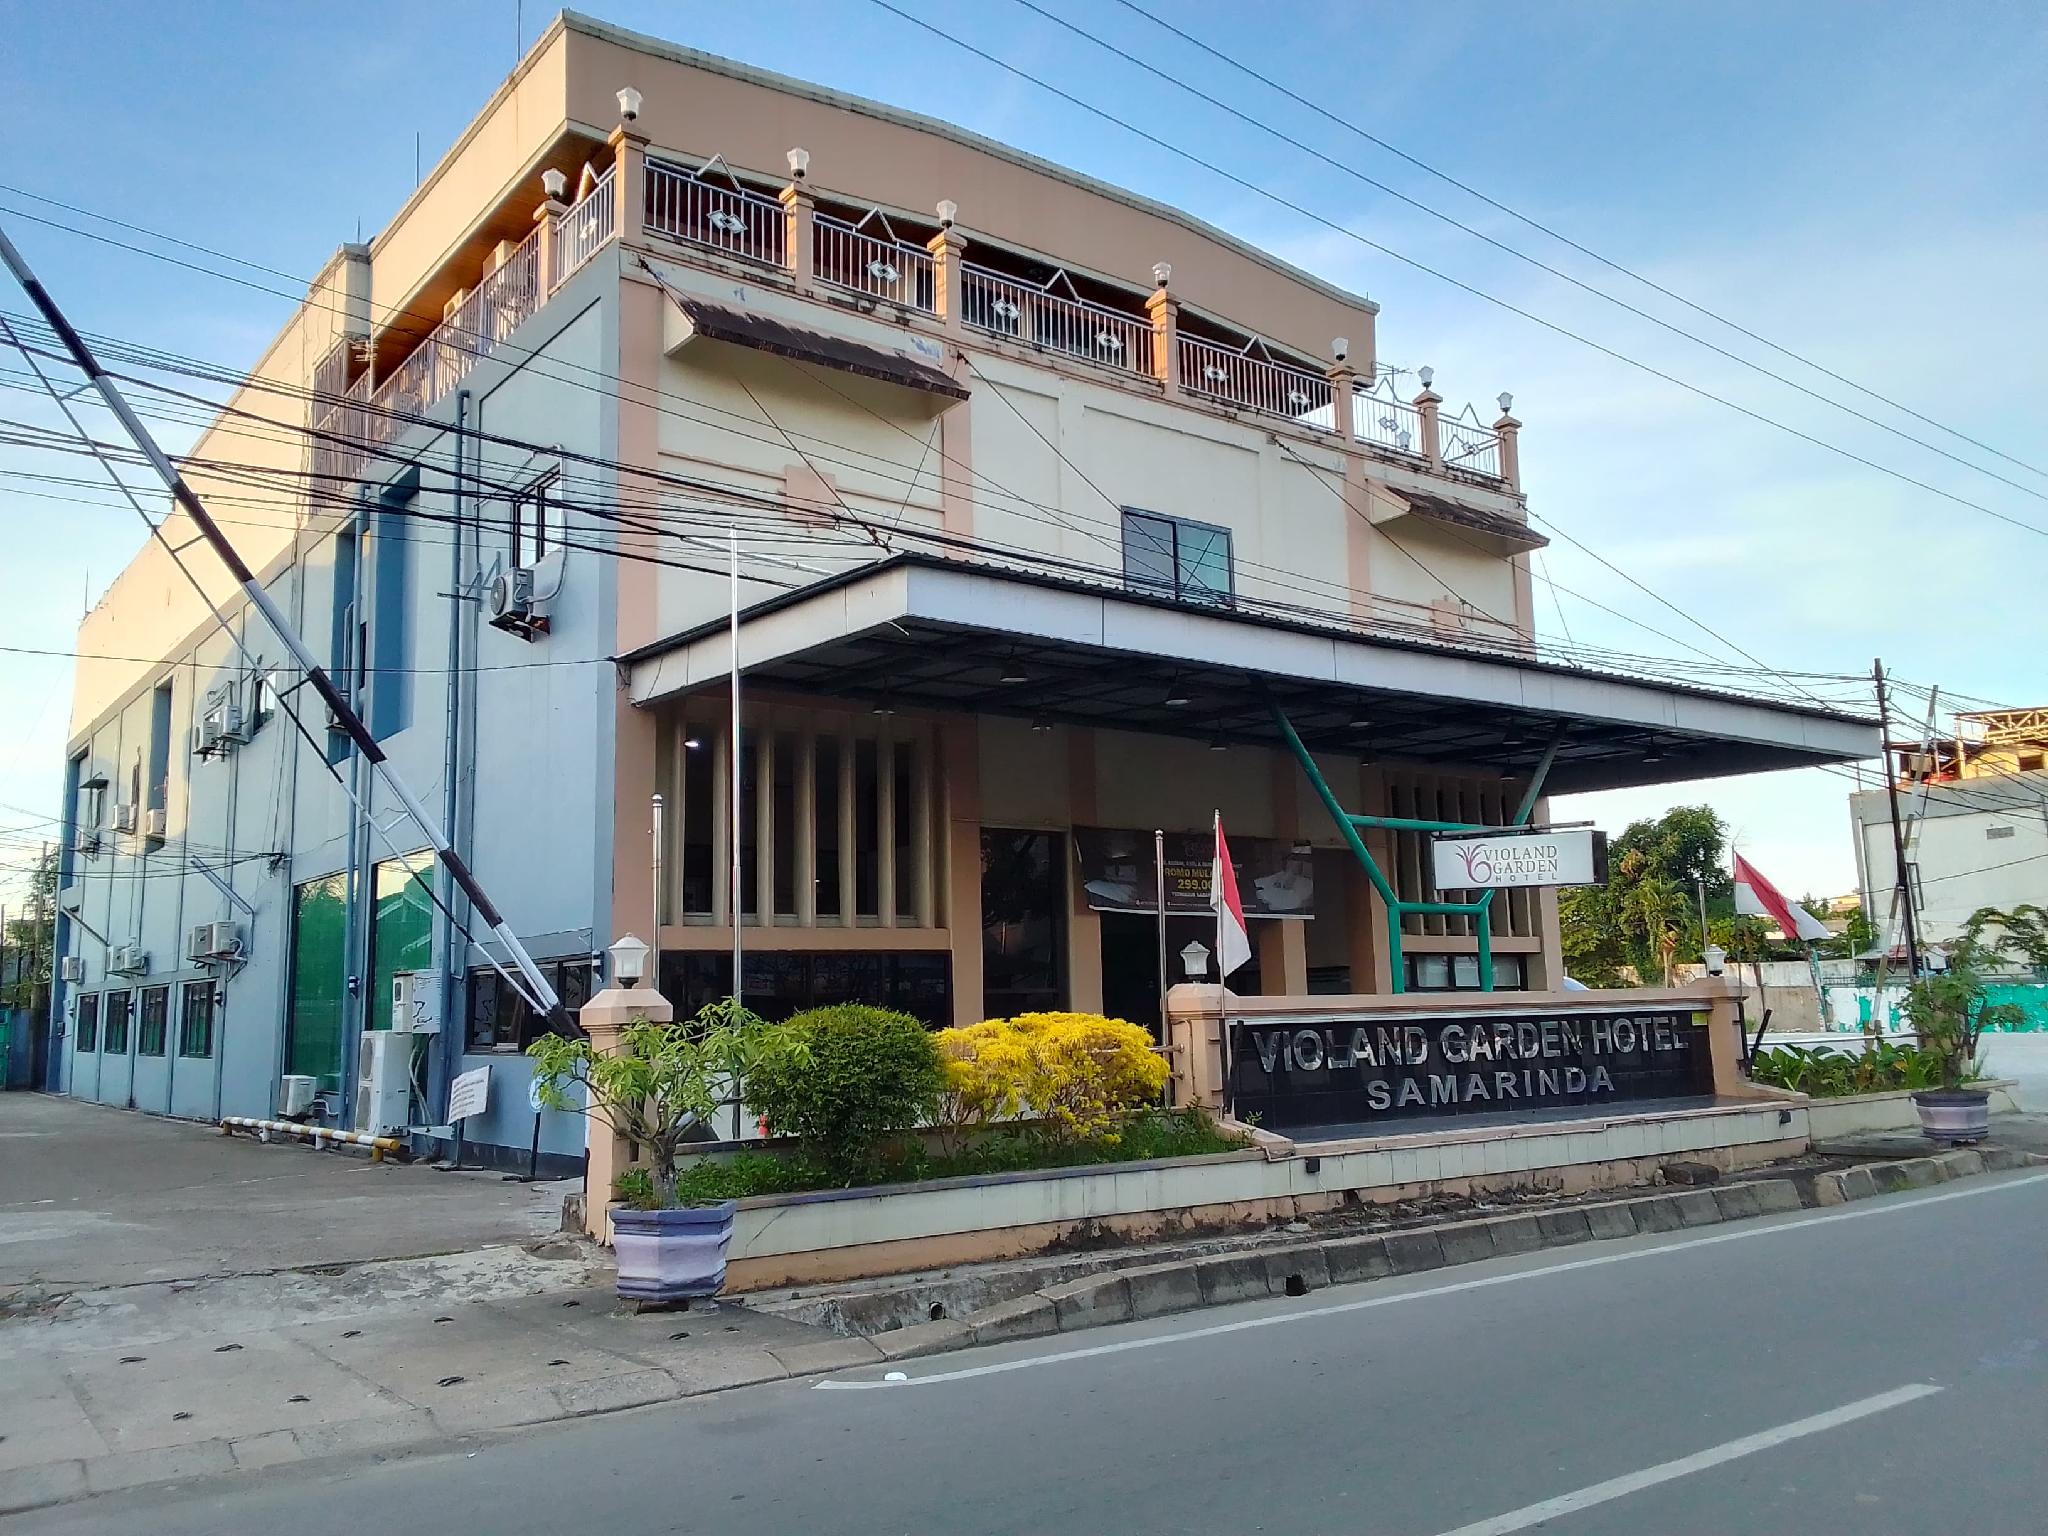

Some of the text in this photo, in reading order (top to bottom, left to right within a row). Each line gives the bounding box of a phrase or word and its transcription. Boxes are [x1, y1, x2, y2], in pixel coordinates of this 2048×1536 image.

[1483, 845, 1558, 861] VIOLAND
[1163, 867, 1190, 878] ROMO
[1493, 859, 1558, 874] GARDEN
[1495, 872, 1557, 882] HOTEL
[1251, 1015, 1689, 1072] VIOLAND GARDEN HOTEL
[1367, 1065, 1616, 1110] SAMARINDA
